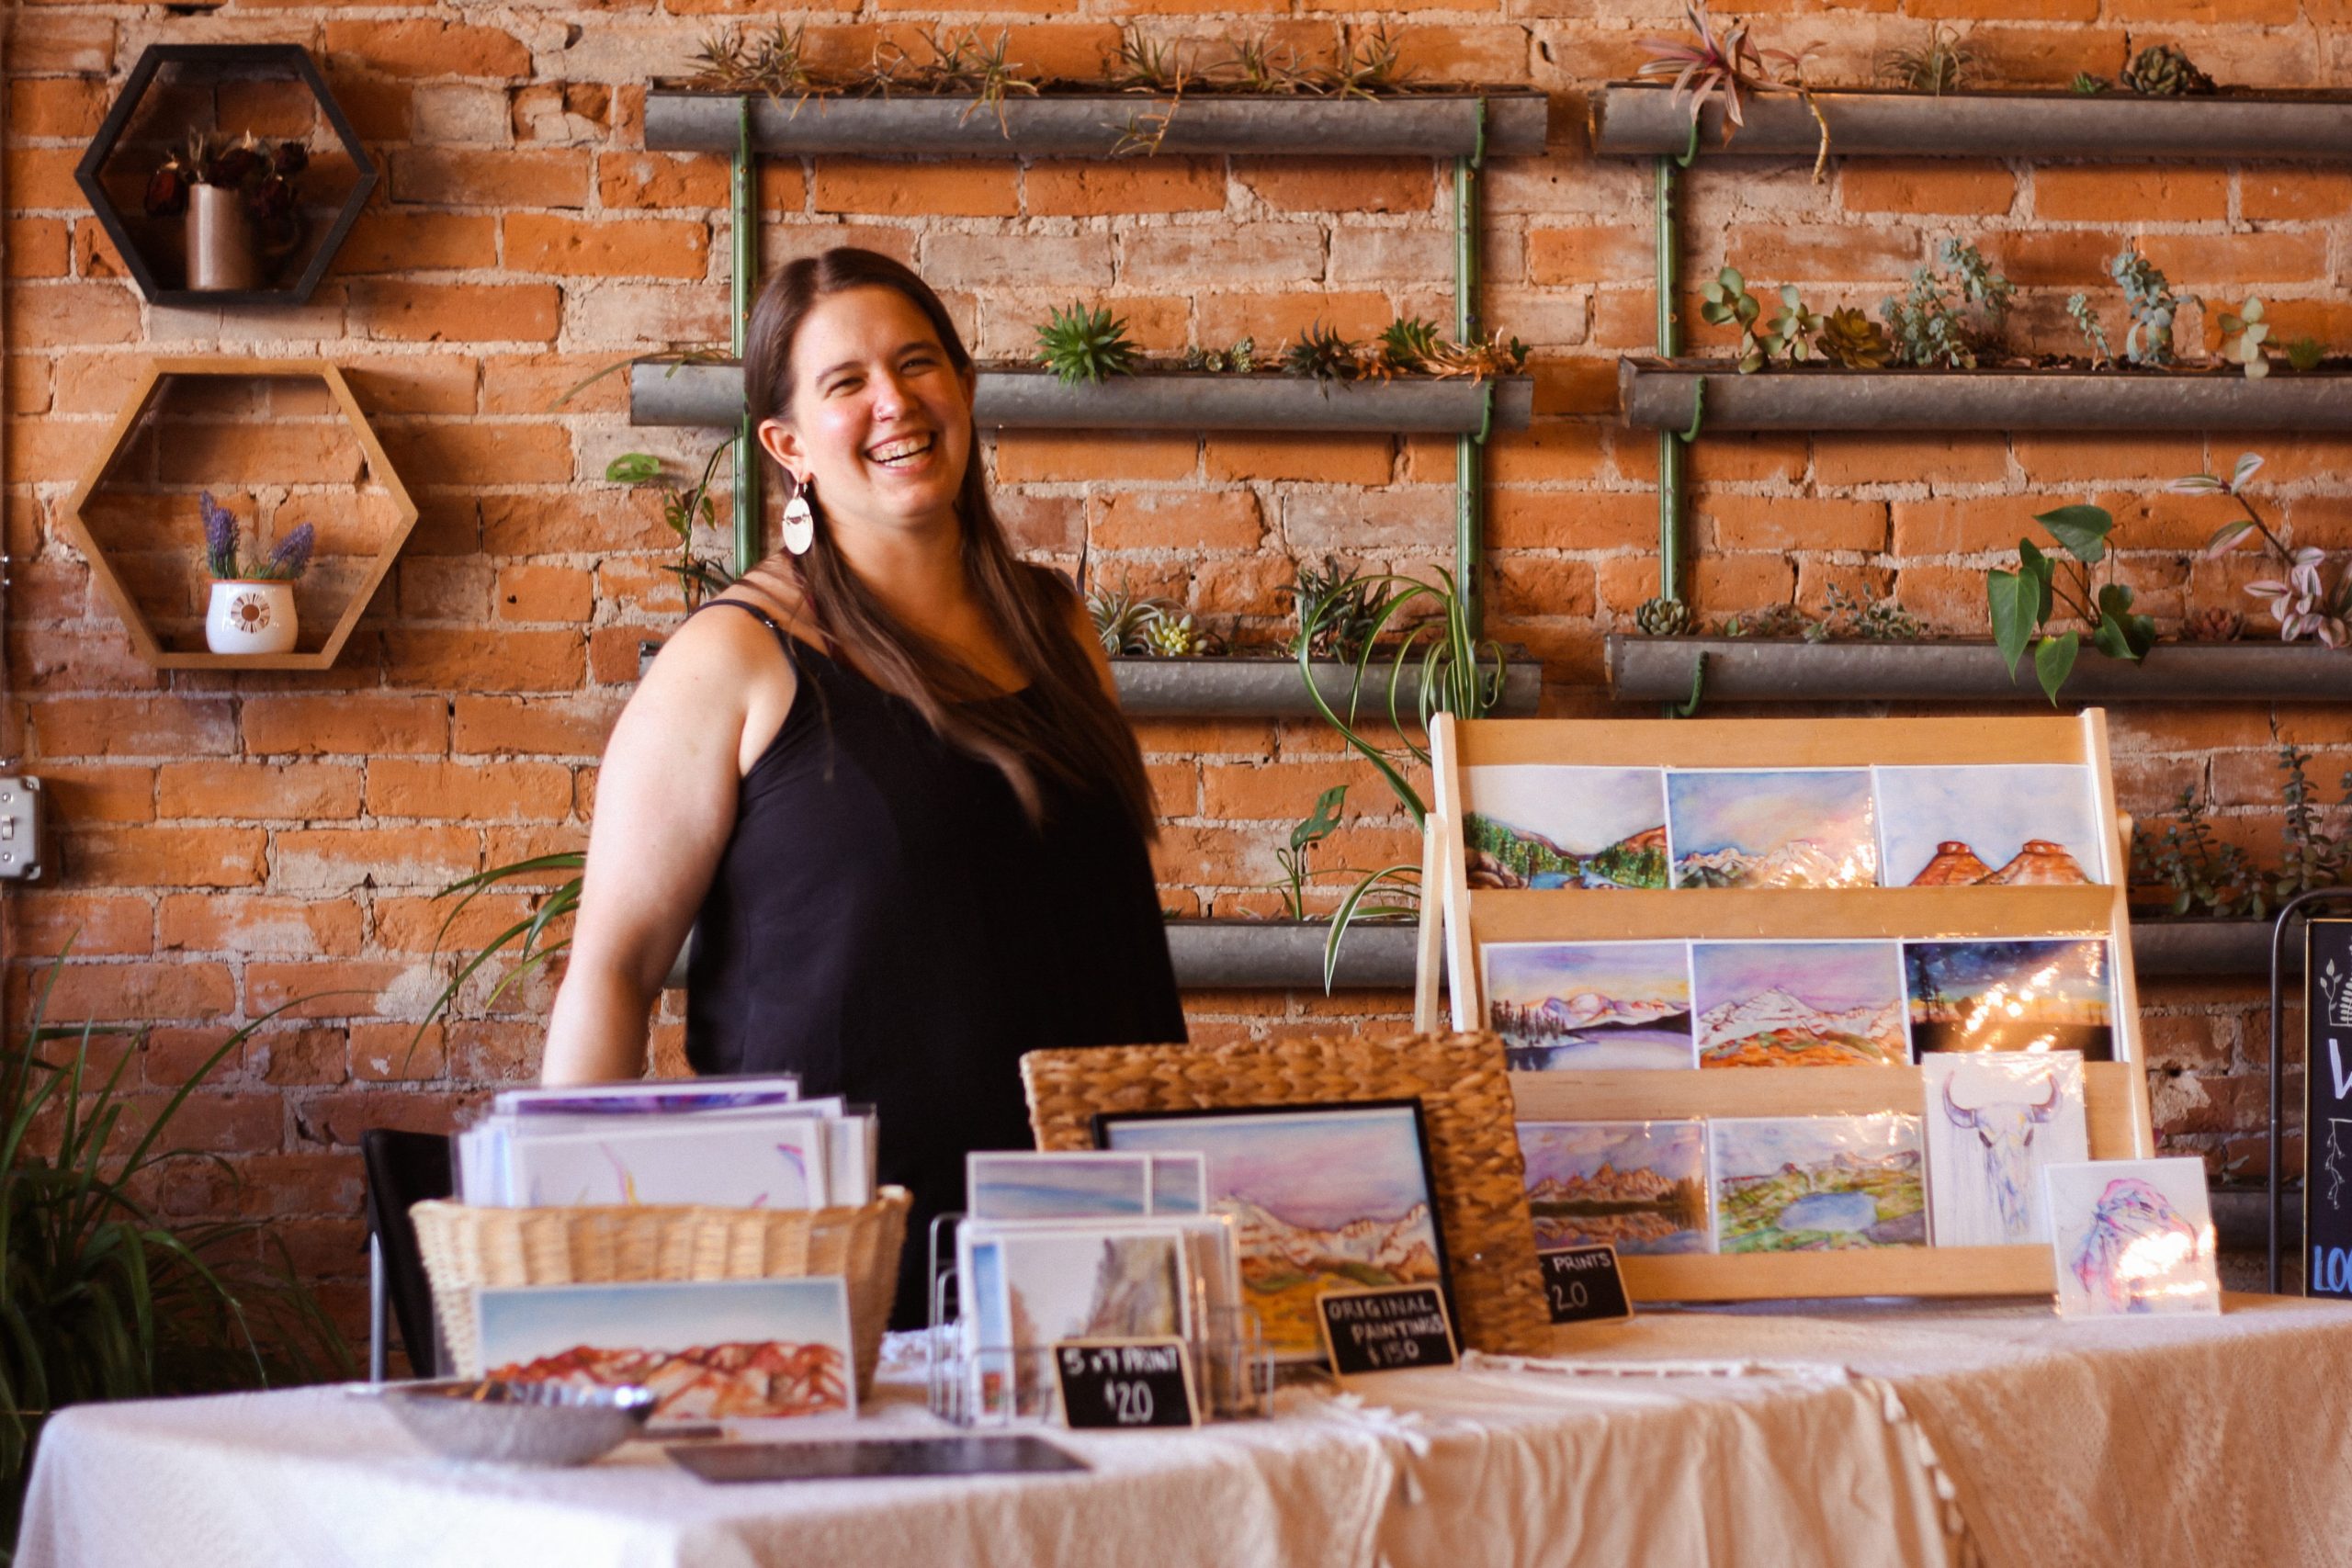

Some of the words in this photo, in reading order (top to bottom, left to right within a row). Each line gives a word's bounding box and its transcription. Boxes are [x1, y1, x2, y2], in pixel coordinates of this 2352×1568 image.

[1553, 1252, 1611, 1273] PRINTS
[2313, 1245, 2352, 1293] LO
[1329, 1295, 1434, 1321] ORIGINAL
[1351, 1314, 1446, 1345] PAINTINGS
